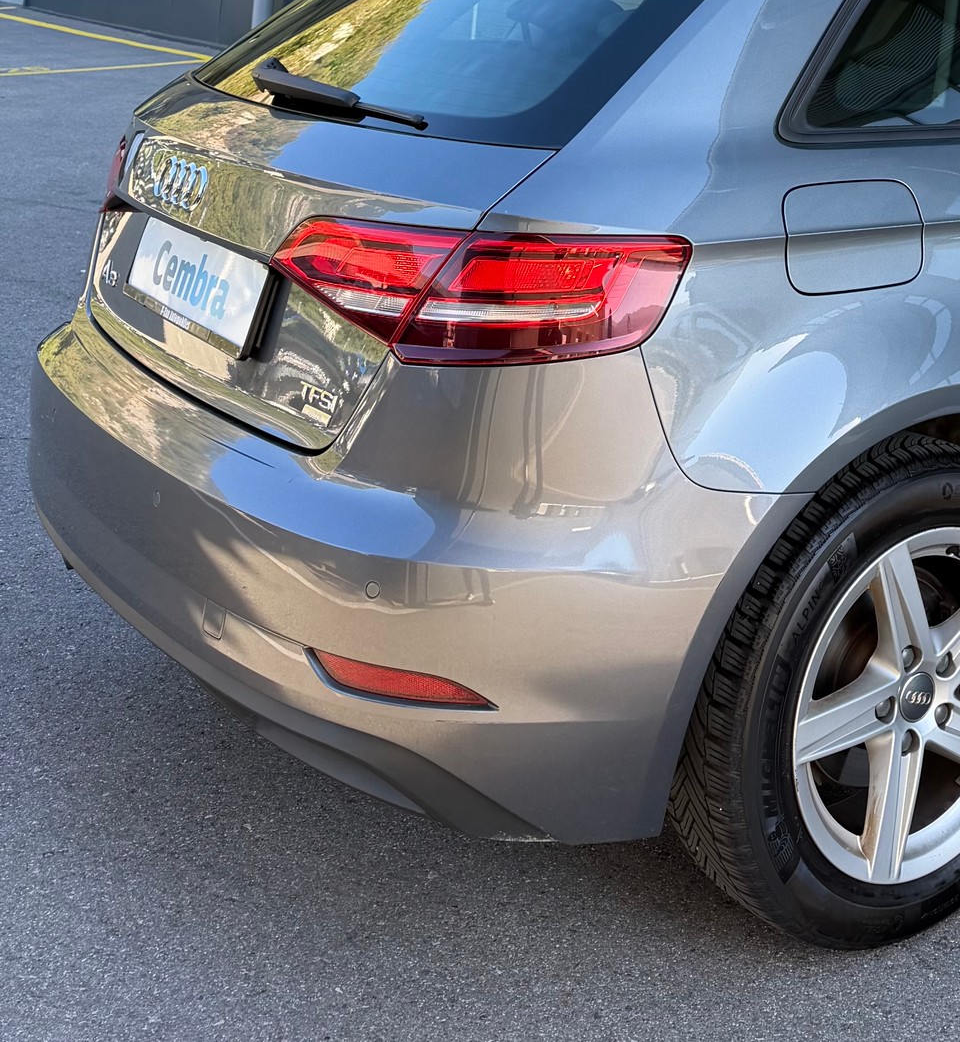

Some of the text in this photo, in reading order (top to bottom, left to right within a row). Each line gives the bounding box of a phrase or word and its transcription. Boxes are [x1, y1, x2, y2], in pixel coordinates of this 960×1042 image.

[152, 240, 230, 320] Cembra
[300, 380, 339, 414] TFSI
[790, 590, 822, 645] ALPIN
